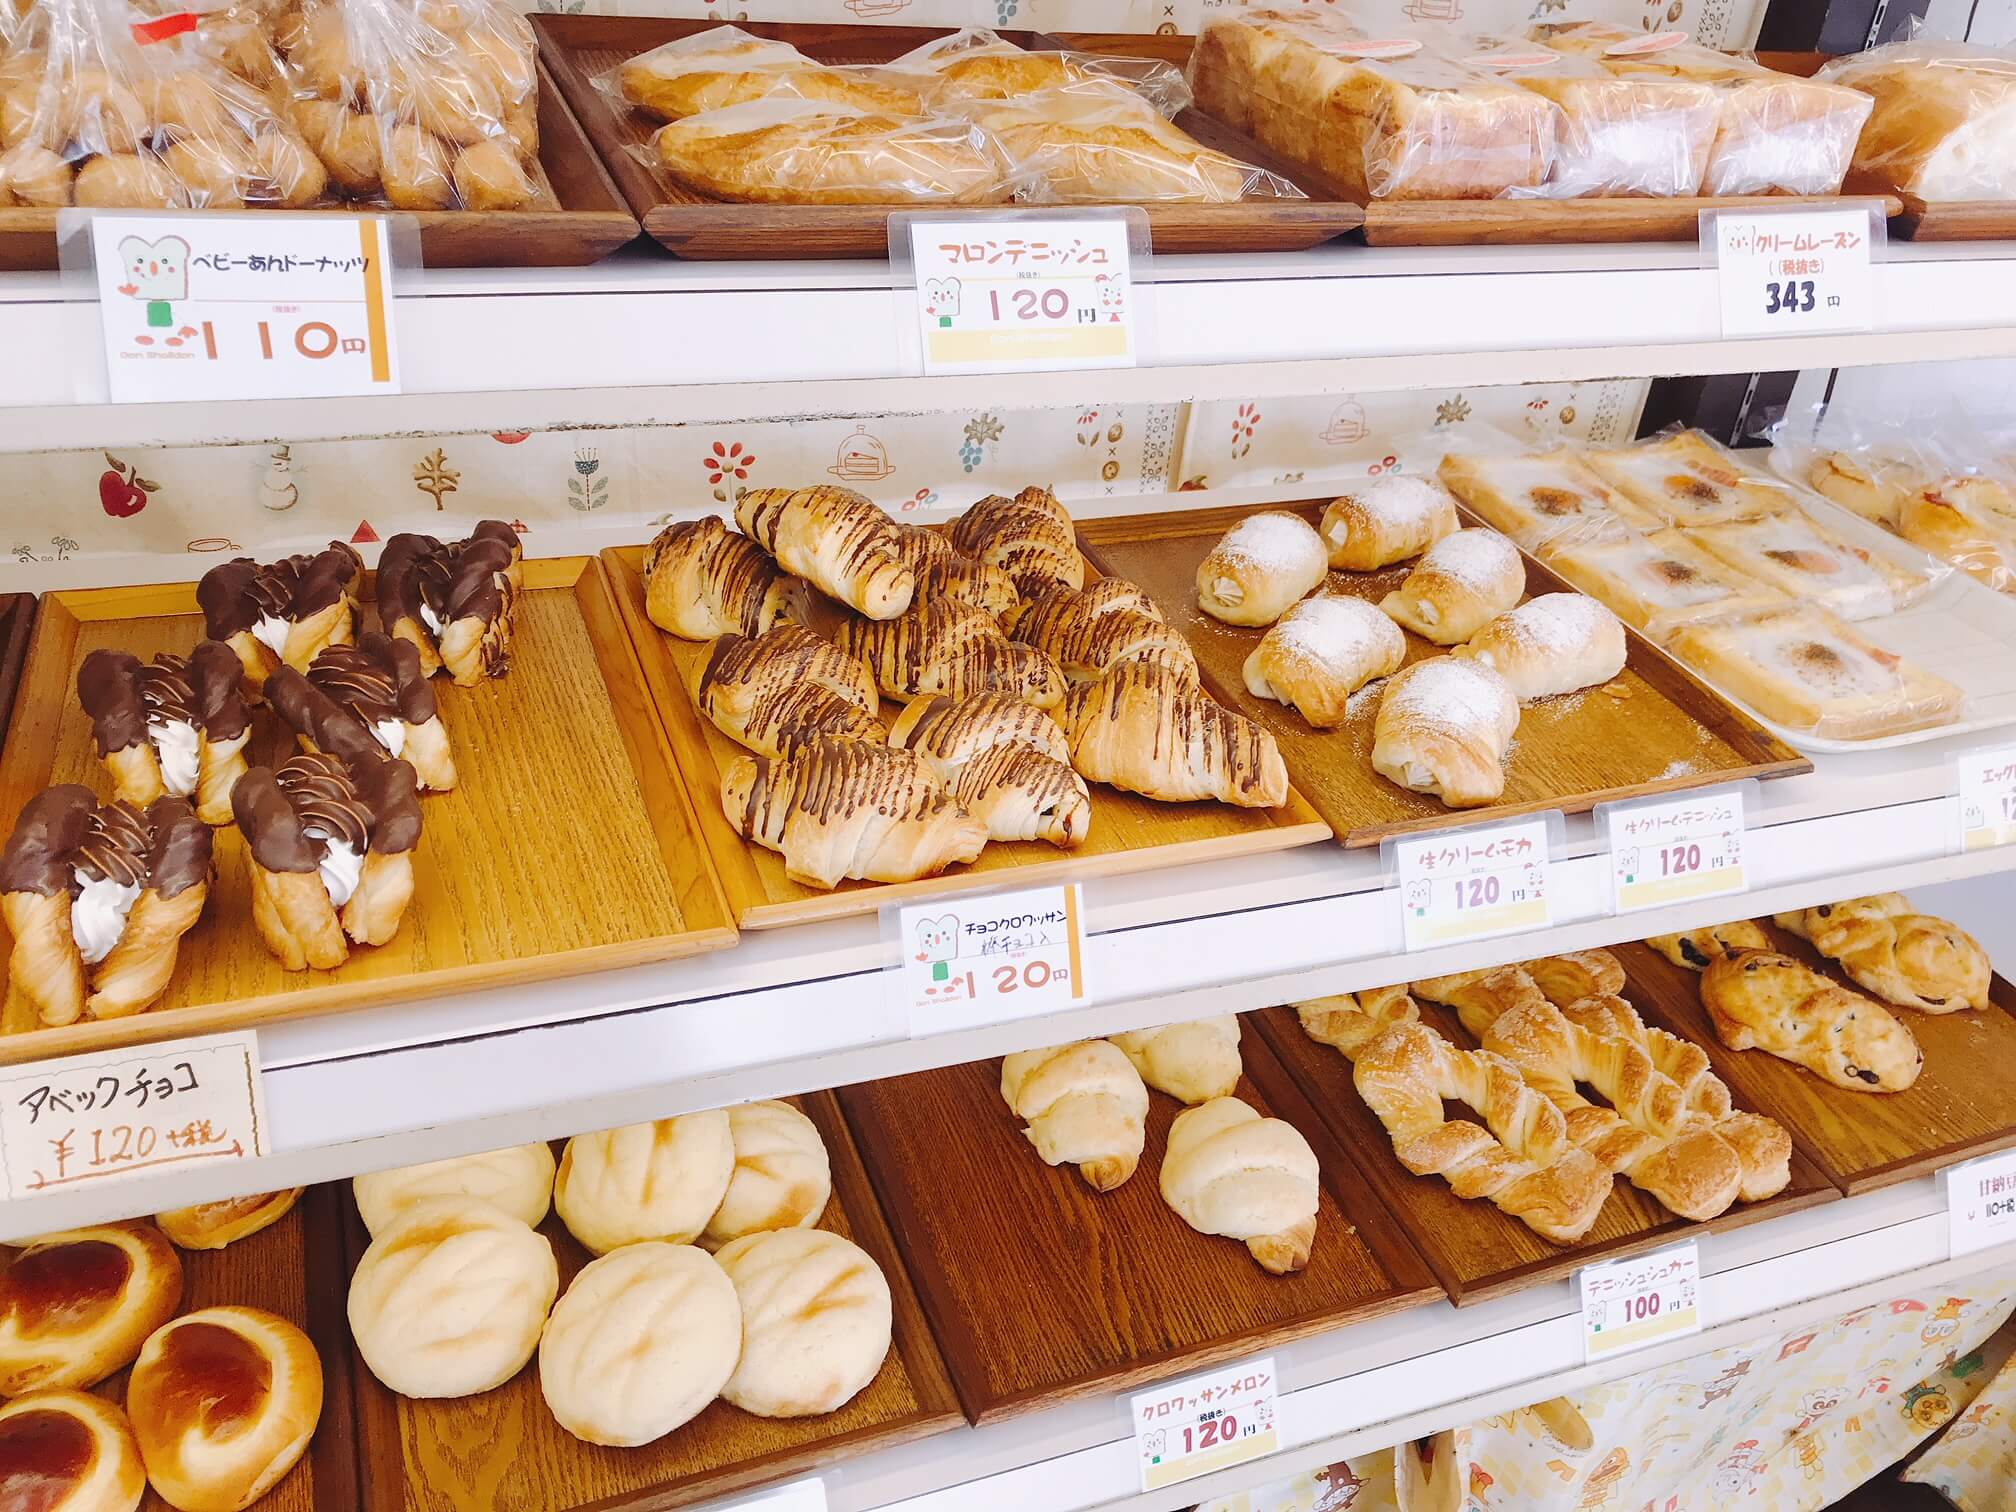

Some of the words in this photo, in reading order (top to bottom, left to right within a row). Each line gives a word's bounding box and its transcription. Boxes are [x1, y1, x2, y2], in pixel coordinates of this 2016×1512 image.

[192, 252, 370, 273] ベビーあんドーナッツ
[989, 288, 1070, 321] 120
[1077, 308, 1097, 324] 円
[1765, 280, 1816, 314] 343
[1660, 844, 1701, 876] 120
[1455, 876, 1500, 909] 120
[965, 910, 1068, 936] チョコクロワッサン
[19, 1062, 200, 1125] アベックチョコ
[1625, 1292, 1660, 1322] 100
[1142, 1373, 1271, 1421] クロワッサンメロン
[1182, 1415, 1237, 1454] 120
